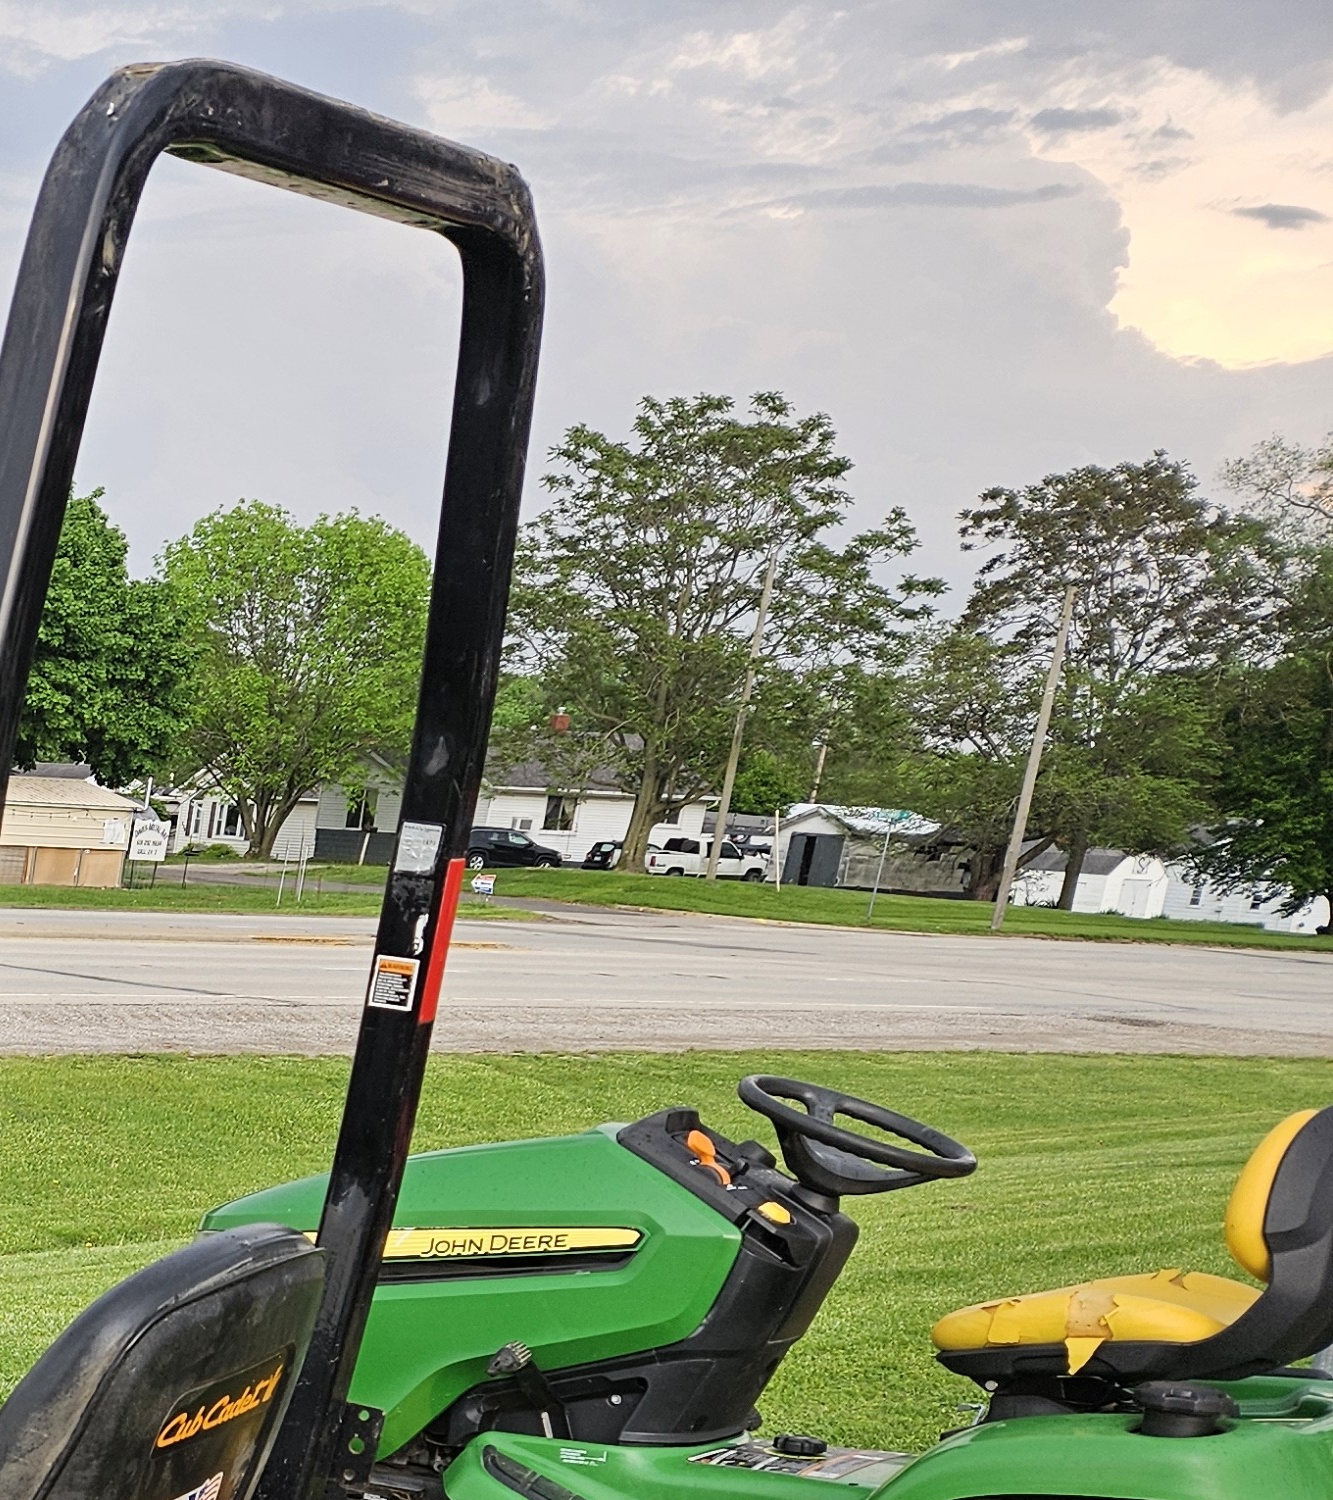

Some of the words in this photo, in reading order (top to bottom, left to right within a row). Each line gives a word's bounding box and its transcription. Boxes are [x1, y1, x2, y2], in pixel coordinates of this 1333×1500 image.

[421, 1238, 483, 1254] JOHN
[489, 1234, 569, 1251] DEERE
[157, 1405, 206, 1448] Cub
[202, 1379, 268, 1430] Cadet
